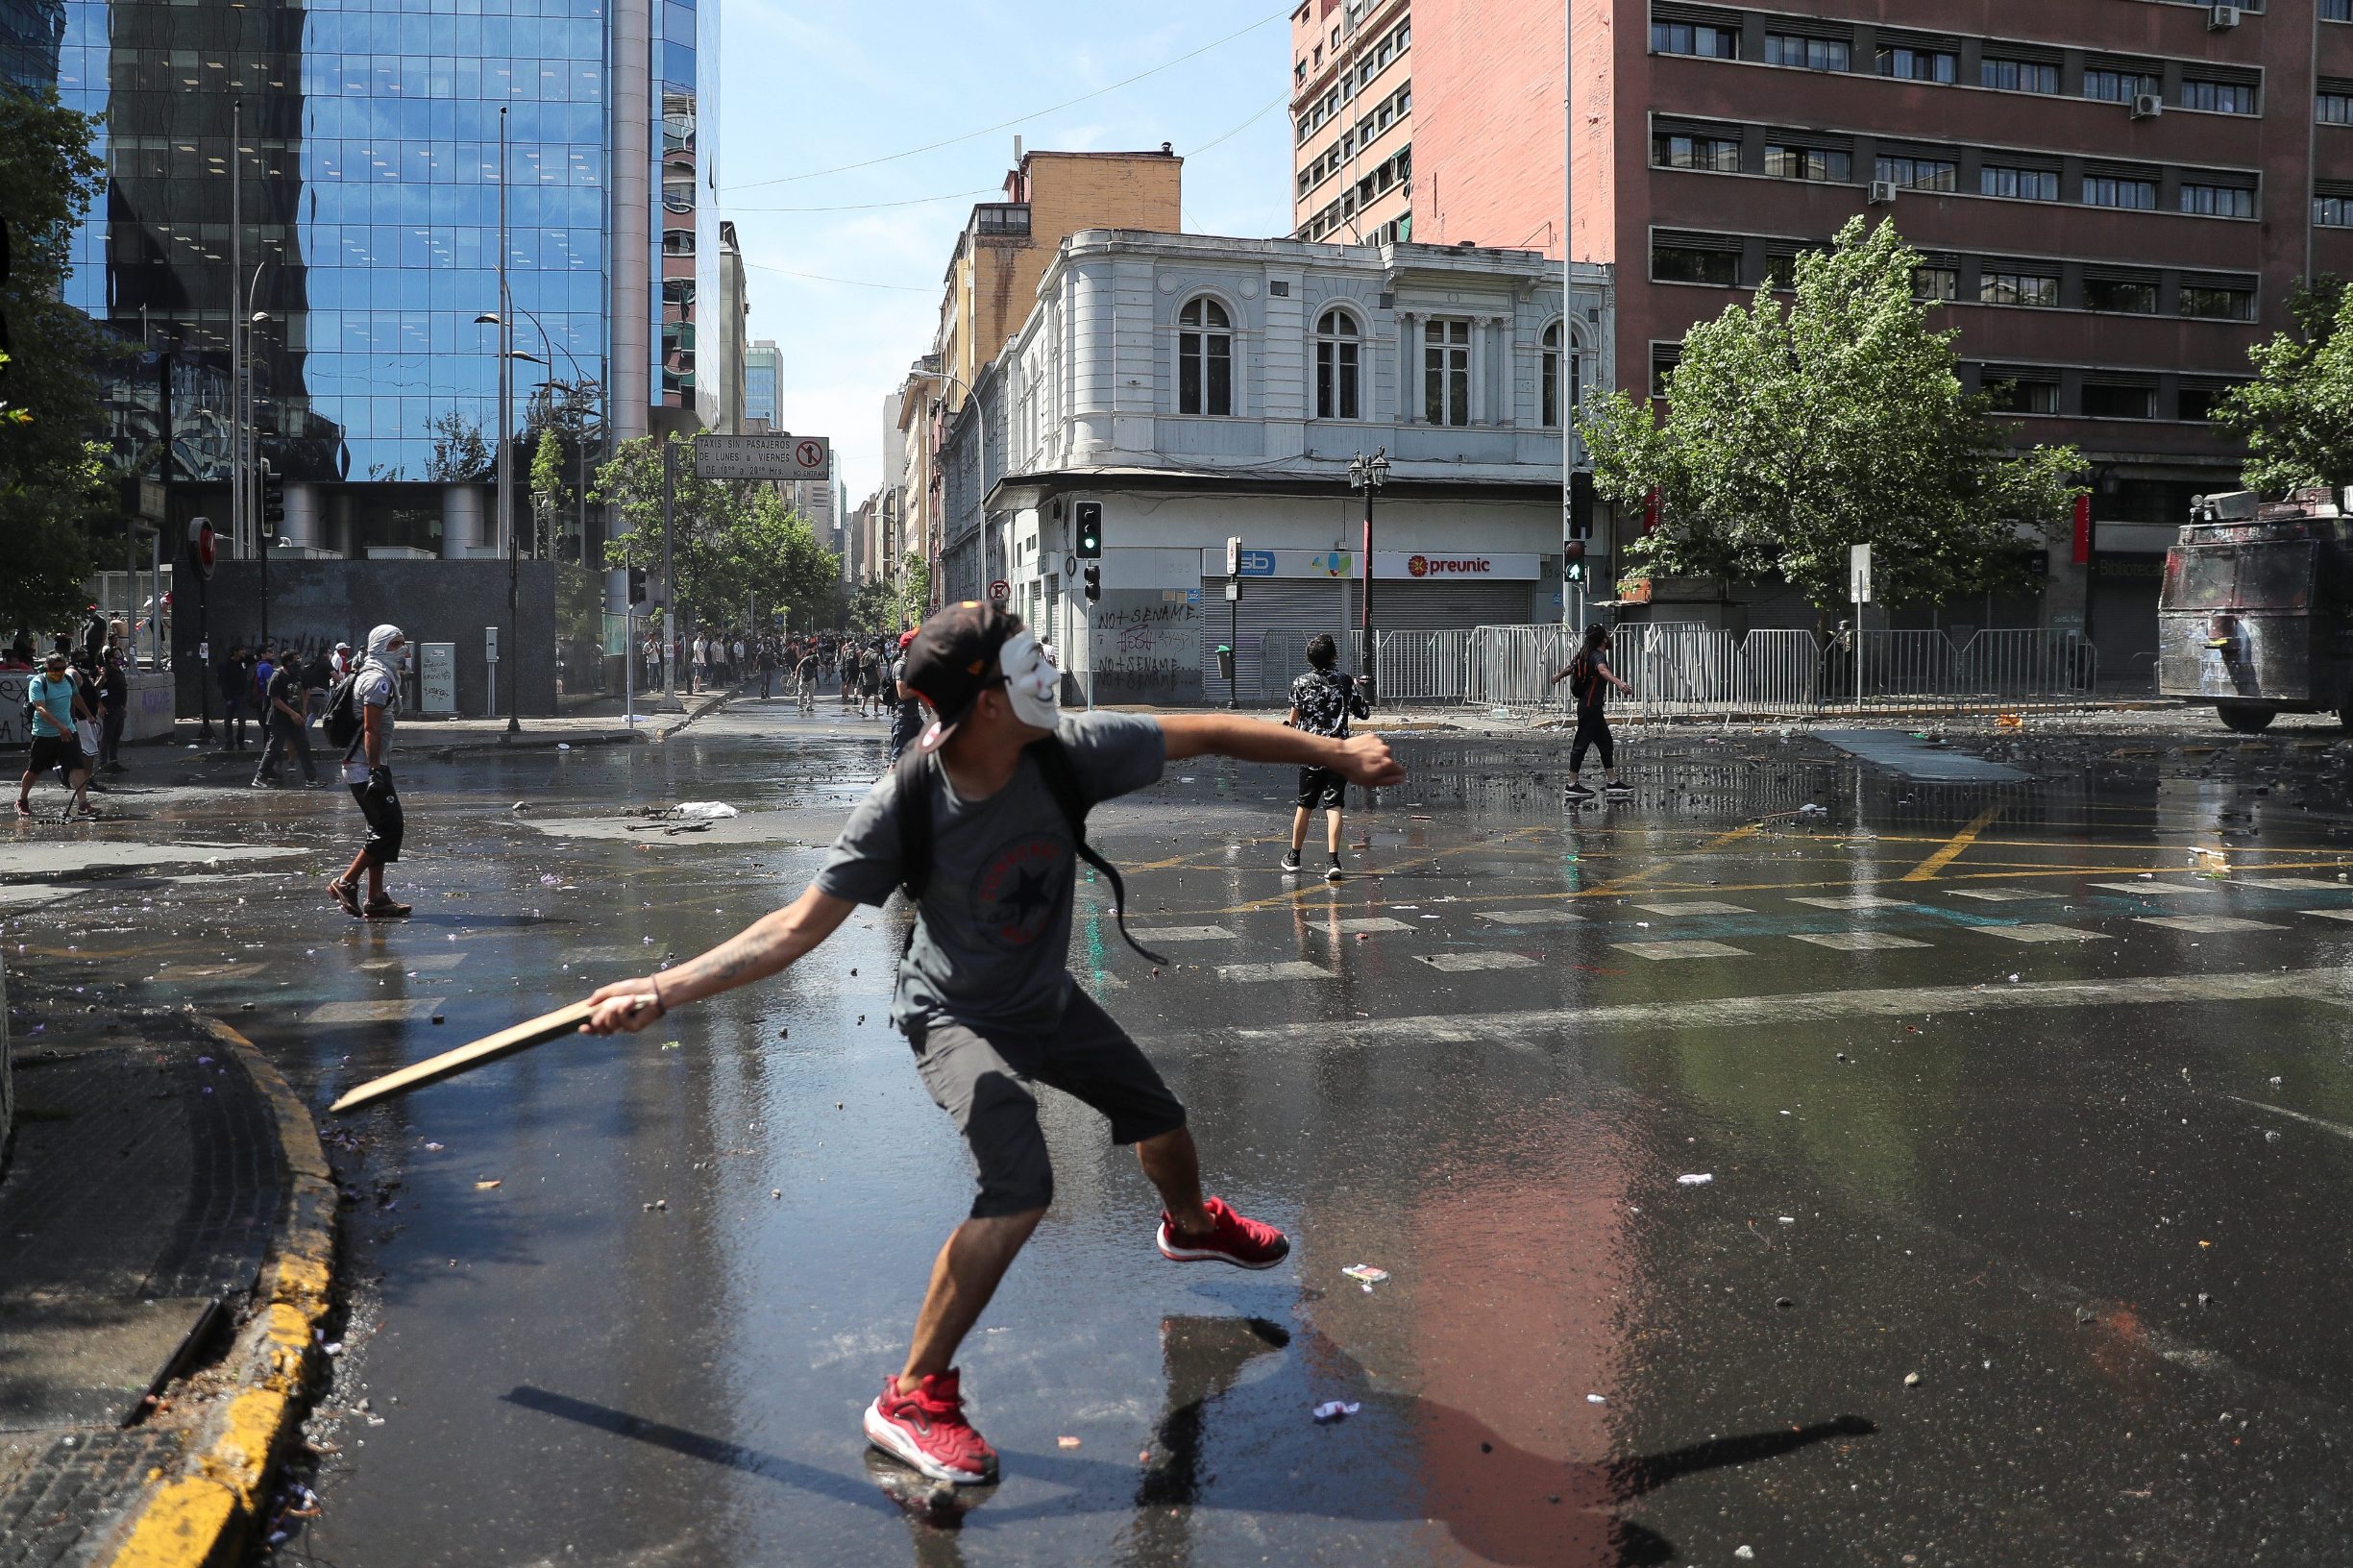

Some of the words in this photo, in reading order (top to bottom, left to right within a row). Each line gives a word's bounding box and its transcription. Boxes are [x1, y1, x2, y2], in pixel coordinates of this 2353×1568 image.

[699, 439, 722, 448] TAXIS
[747, 440, 791, 450] PASAJEROS
[699, 453, 709, 461] DE
[715, 453, 740, 462] LUNES
[758, 453, 790, 462] VIERNES
[706, 466, 716, 475] DE
[770, 467, 784, 476] Hrs.
[1430, 557, 1490, 576] preunic
